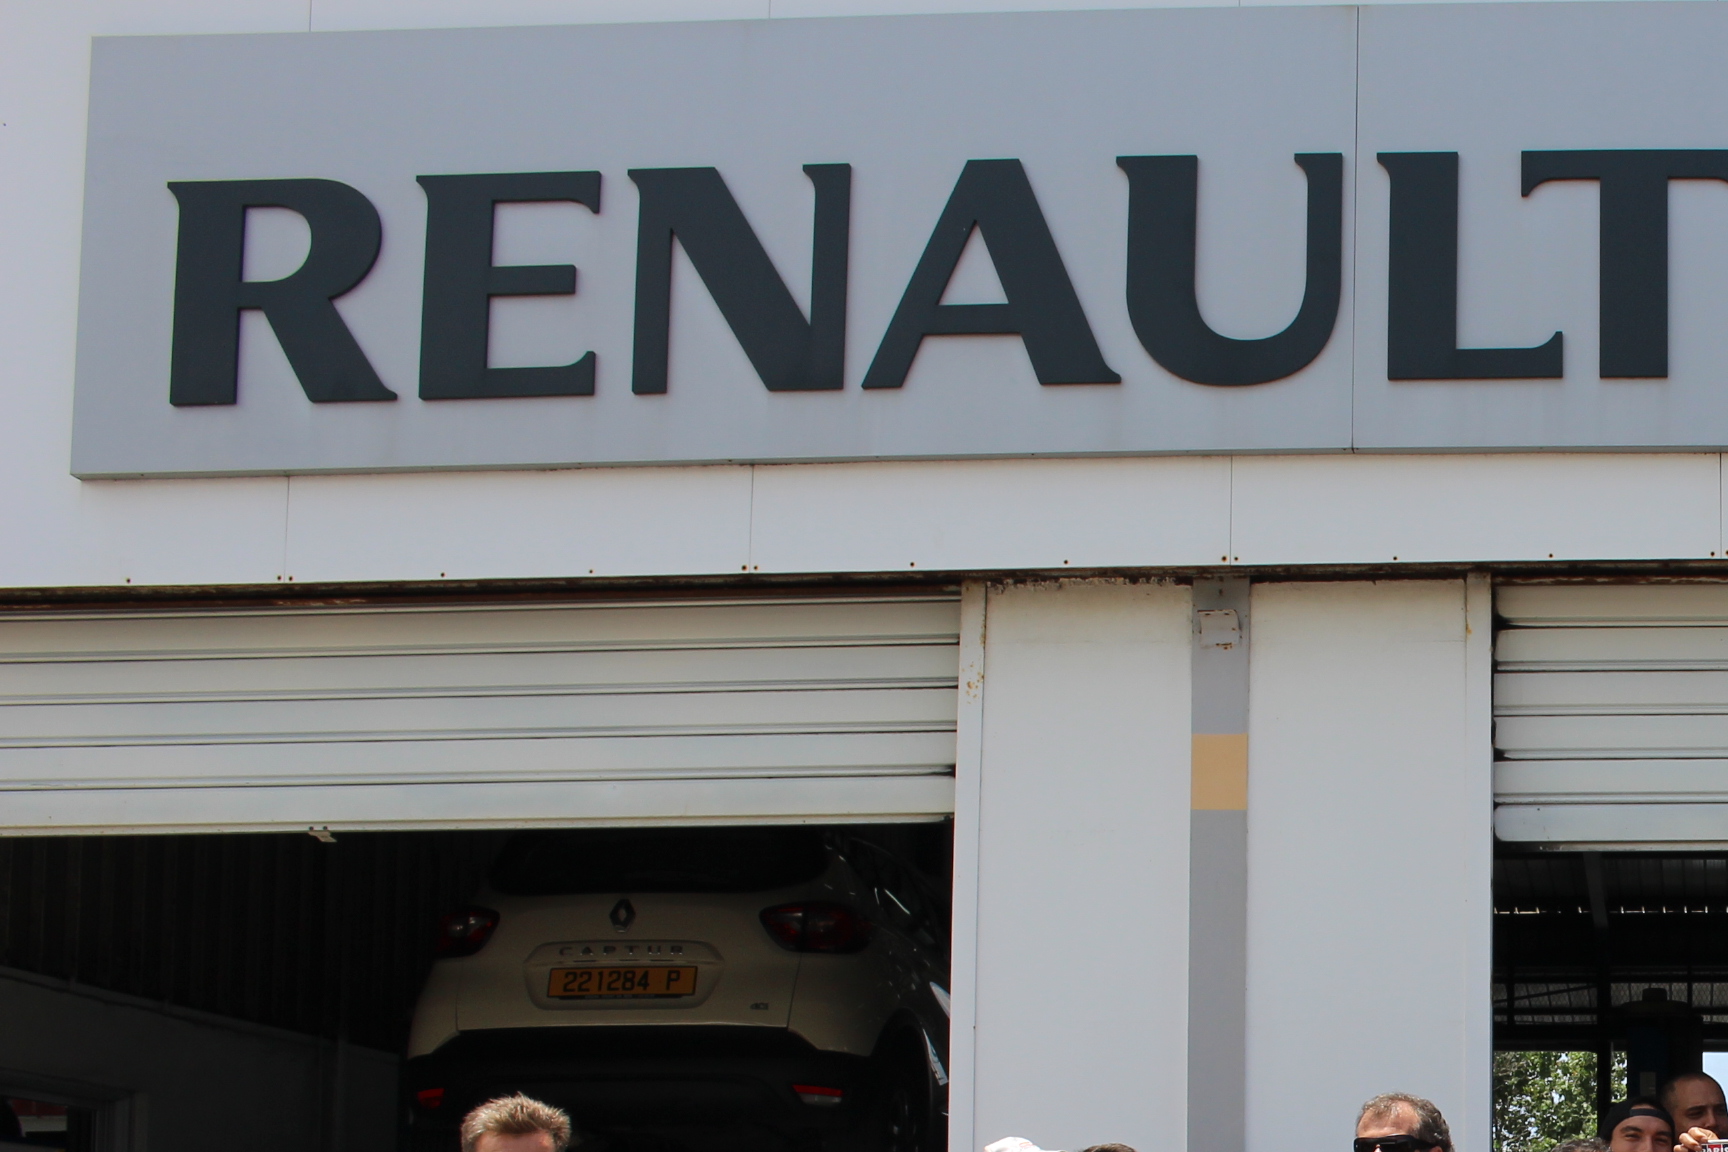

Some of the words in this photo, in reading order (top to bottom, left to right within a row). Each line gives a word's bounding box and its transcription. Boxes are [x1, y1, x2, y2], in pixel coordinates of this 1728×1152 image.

[559, 945, 683, 956] CAPTUR
[563, 970, 650, 992] 221284
[666, 970, 681, 991] P
